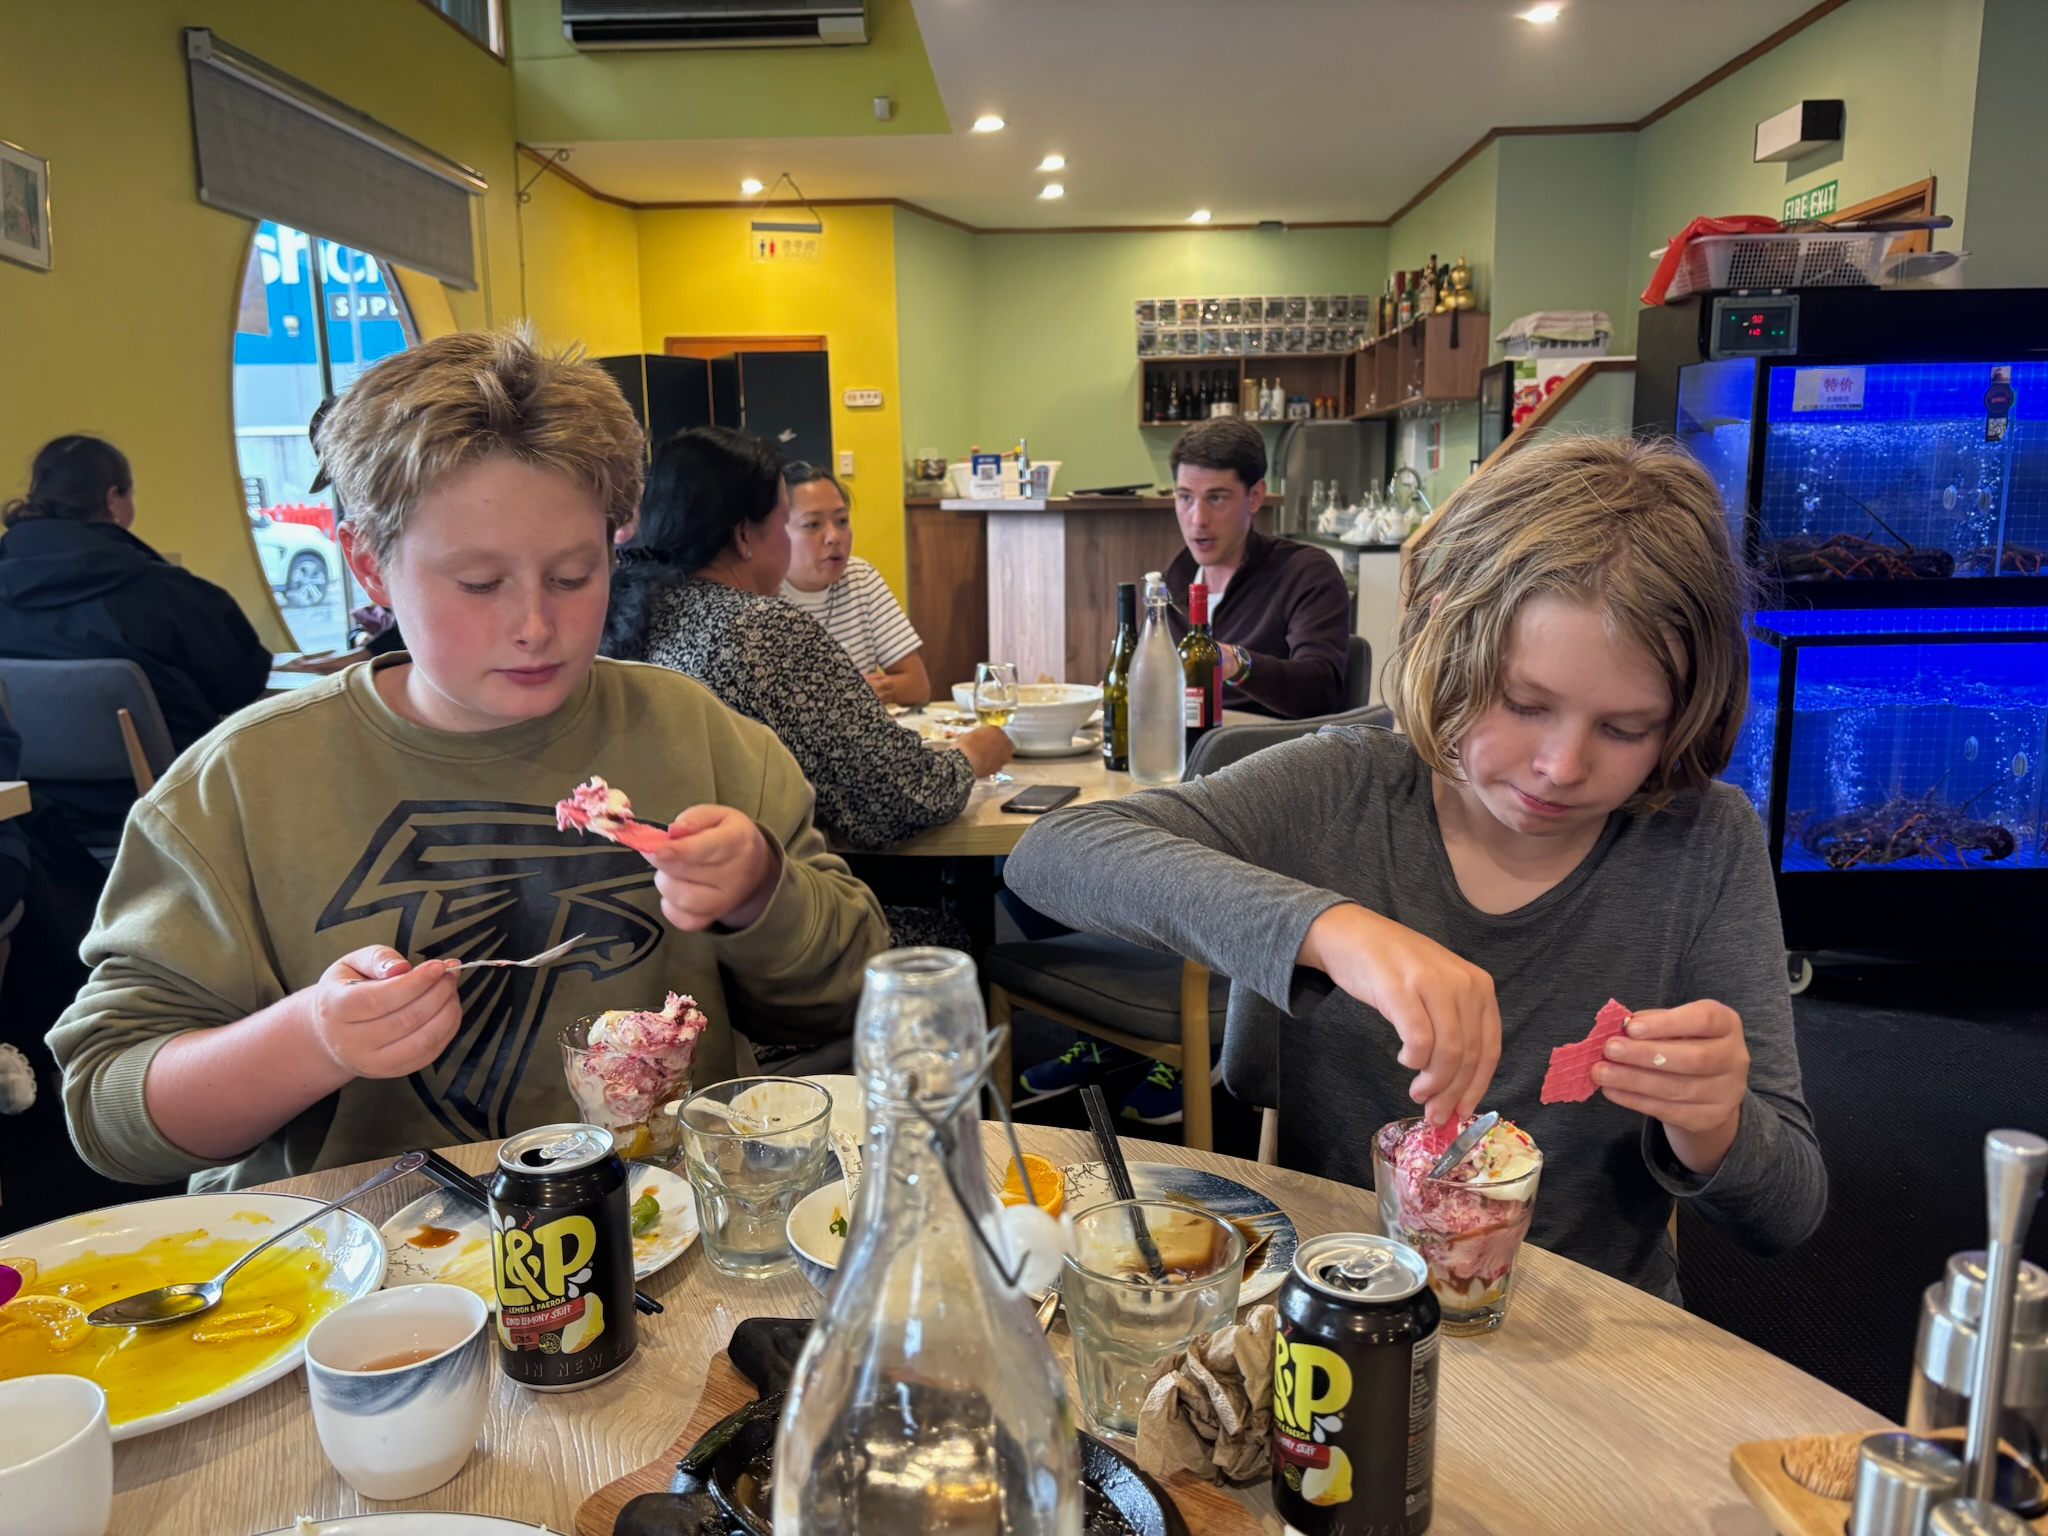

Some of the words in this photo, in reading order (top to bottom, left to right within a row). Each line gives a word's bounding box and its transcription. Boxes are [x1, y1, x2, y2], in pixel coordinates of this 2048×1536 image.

[1785, 195, 1808, 221] FIRE
[1810, 184, 1836, 218] EXIT
[494, 1215, 597, 1307] L&P
[509, 1307, 530, 1315] LEMON
[537, 1296, 566, 1311] PAEROA
[521, 1313, 549, 1326] LEMONY
[551, 1304, 573, 1319] STUFF
[558, 1352, 603, 1378] NEW
